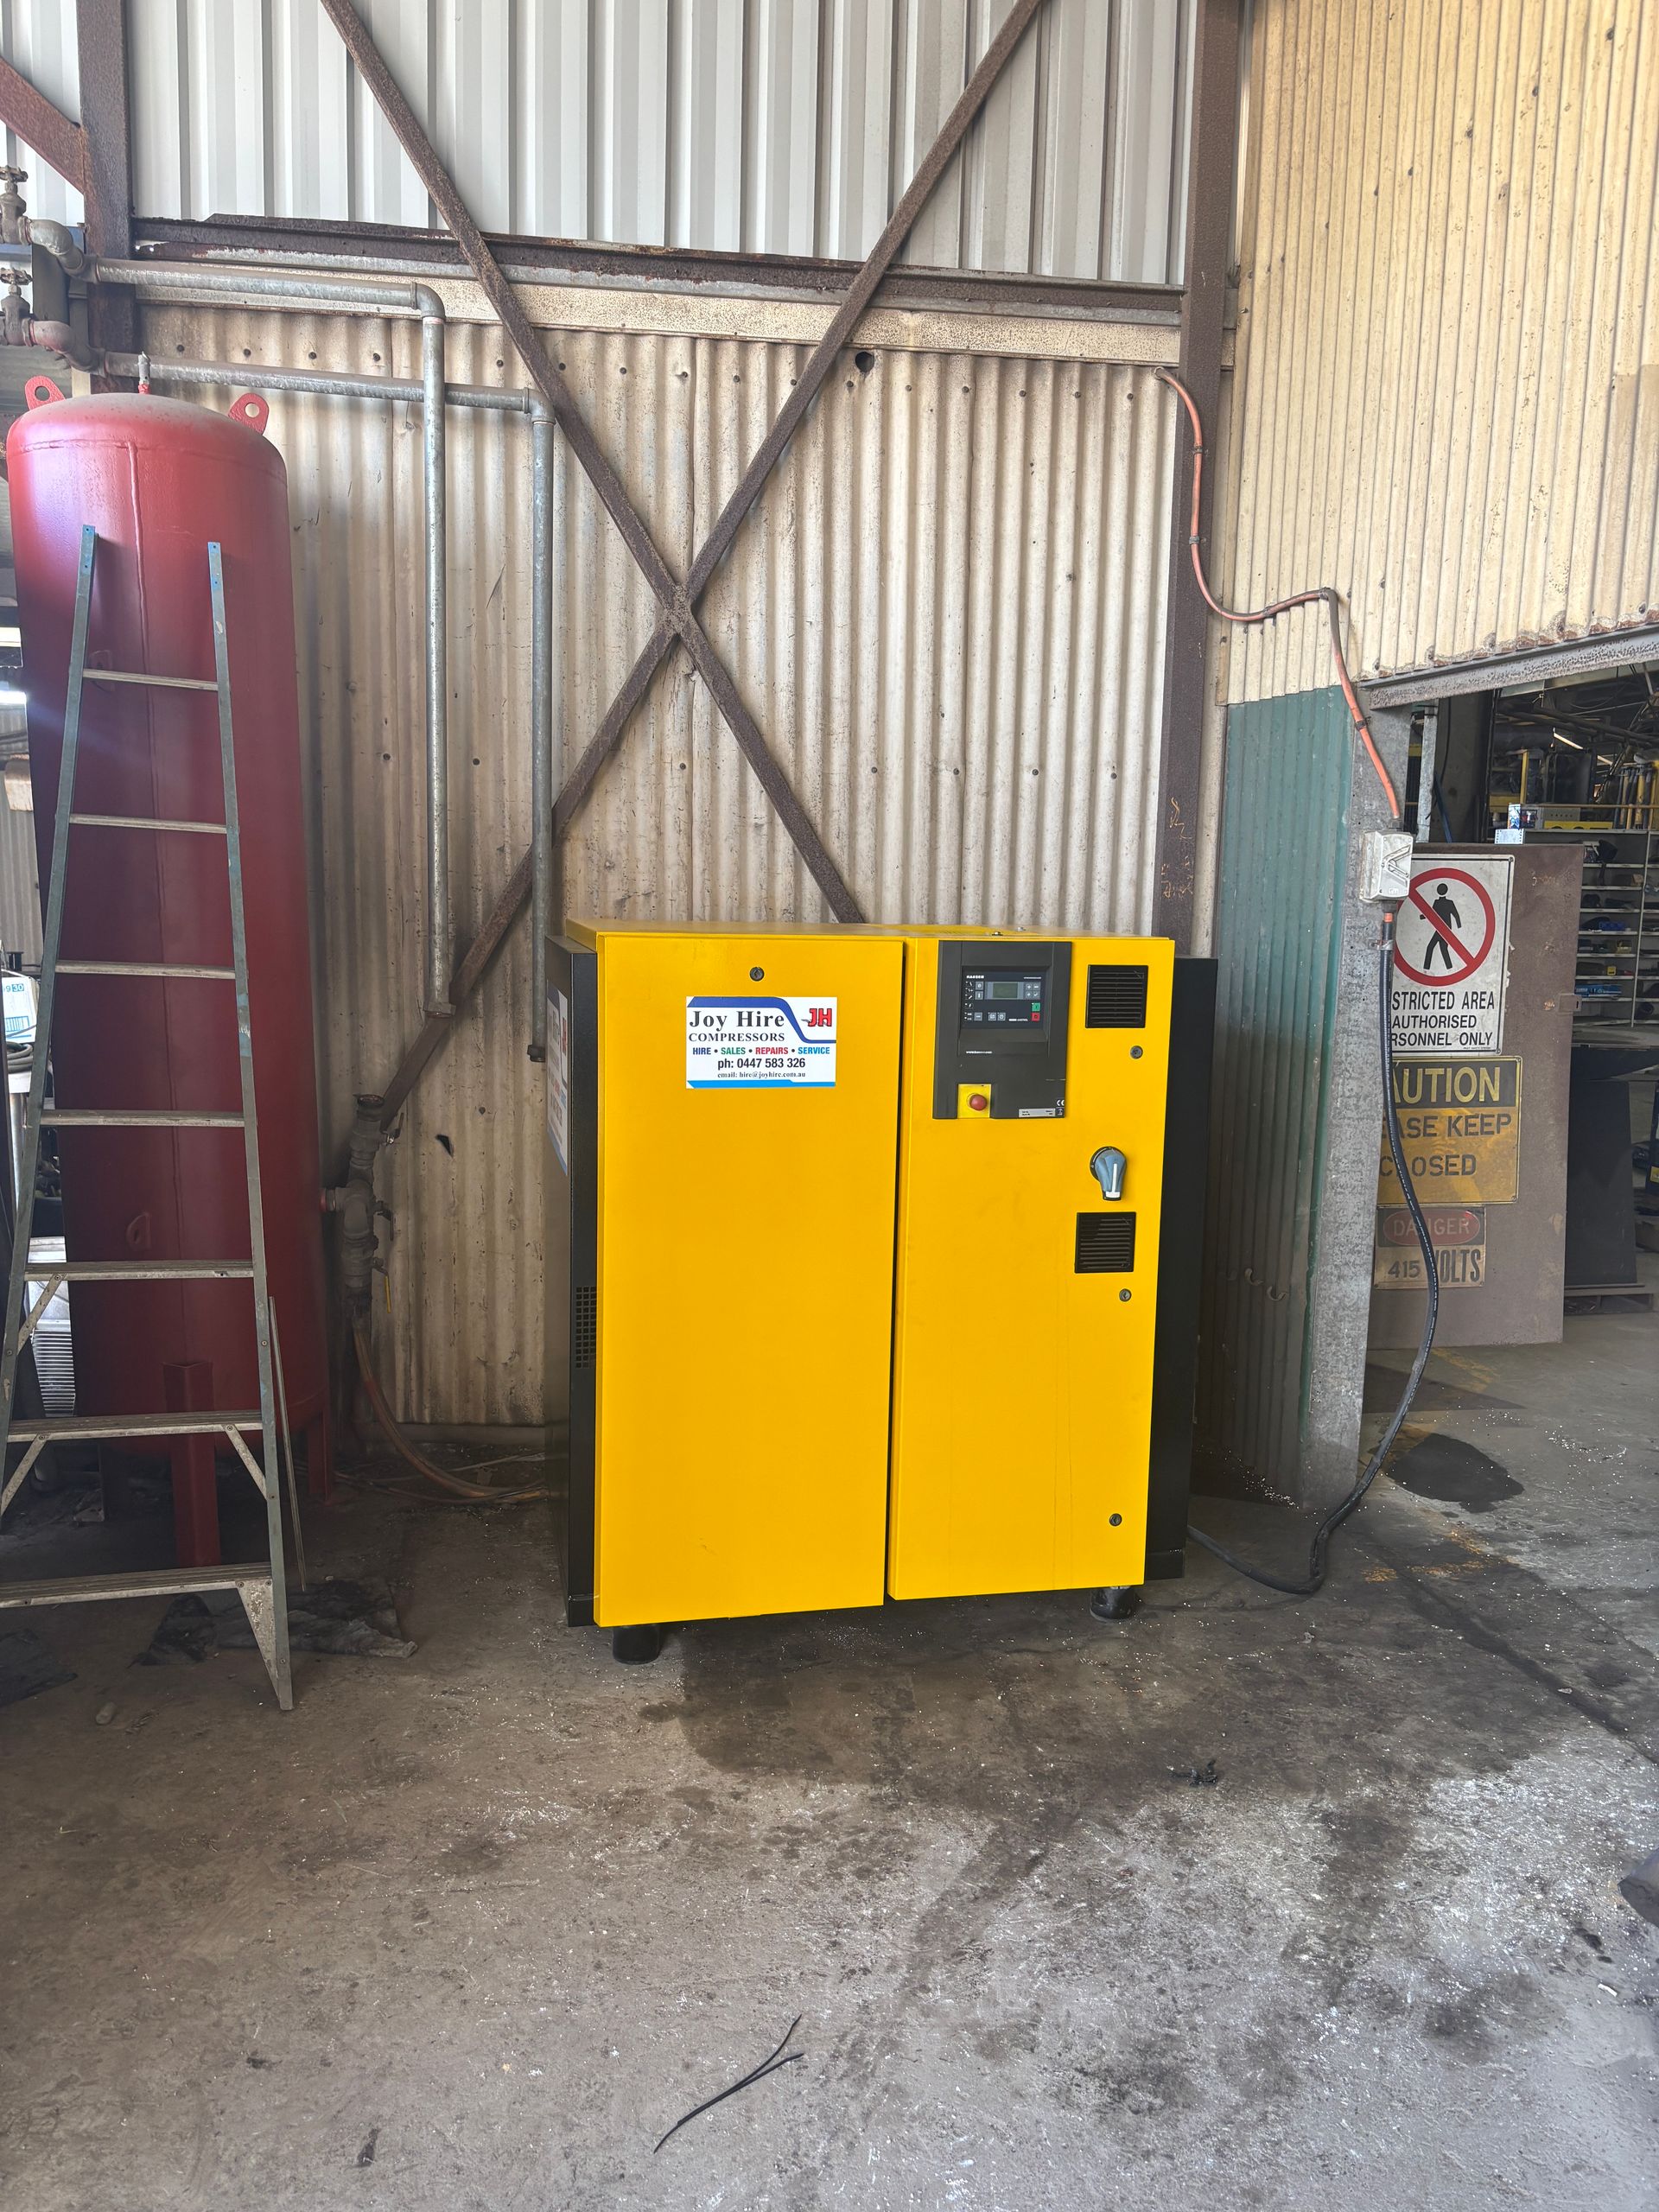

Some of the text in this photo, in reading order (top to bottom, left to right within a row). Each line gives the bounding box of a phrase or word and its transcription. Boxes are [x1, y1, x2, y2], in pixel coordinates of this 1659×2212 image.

[1392, 991, 1495, 1010] STRICTED AREA
[689, 1010, 785, 1032] Joy Hire
[807, 1007, 832, 1027] JH
[1392, 1014, 1478, 1028] AUTHORISED
[689, 1033, 785, 1042] COMPRESSORS
[1391, 1032, 1493, 1046] RSONNEL ONLY
[717, 1058, 806, 1071] ph: 0447 583 326
[1447, 1112, 1512, 1137] KEEP
[1380, 1154, 1477, 1177] COSED
[1388, 1260, 1421, 1278] 415
